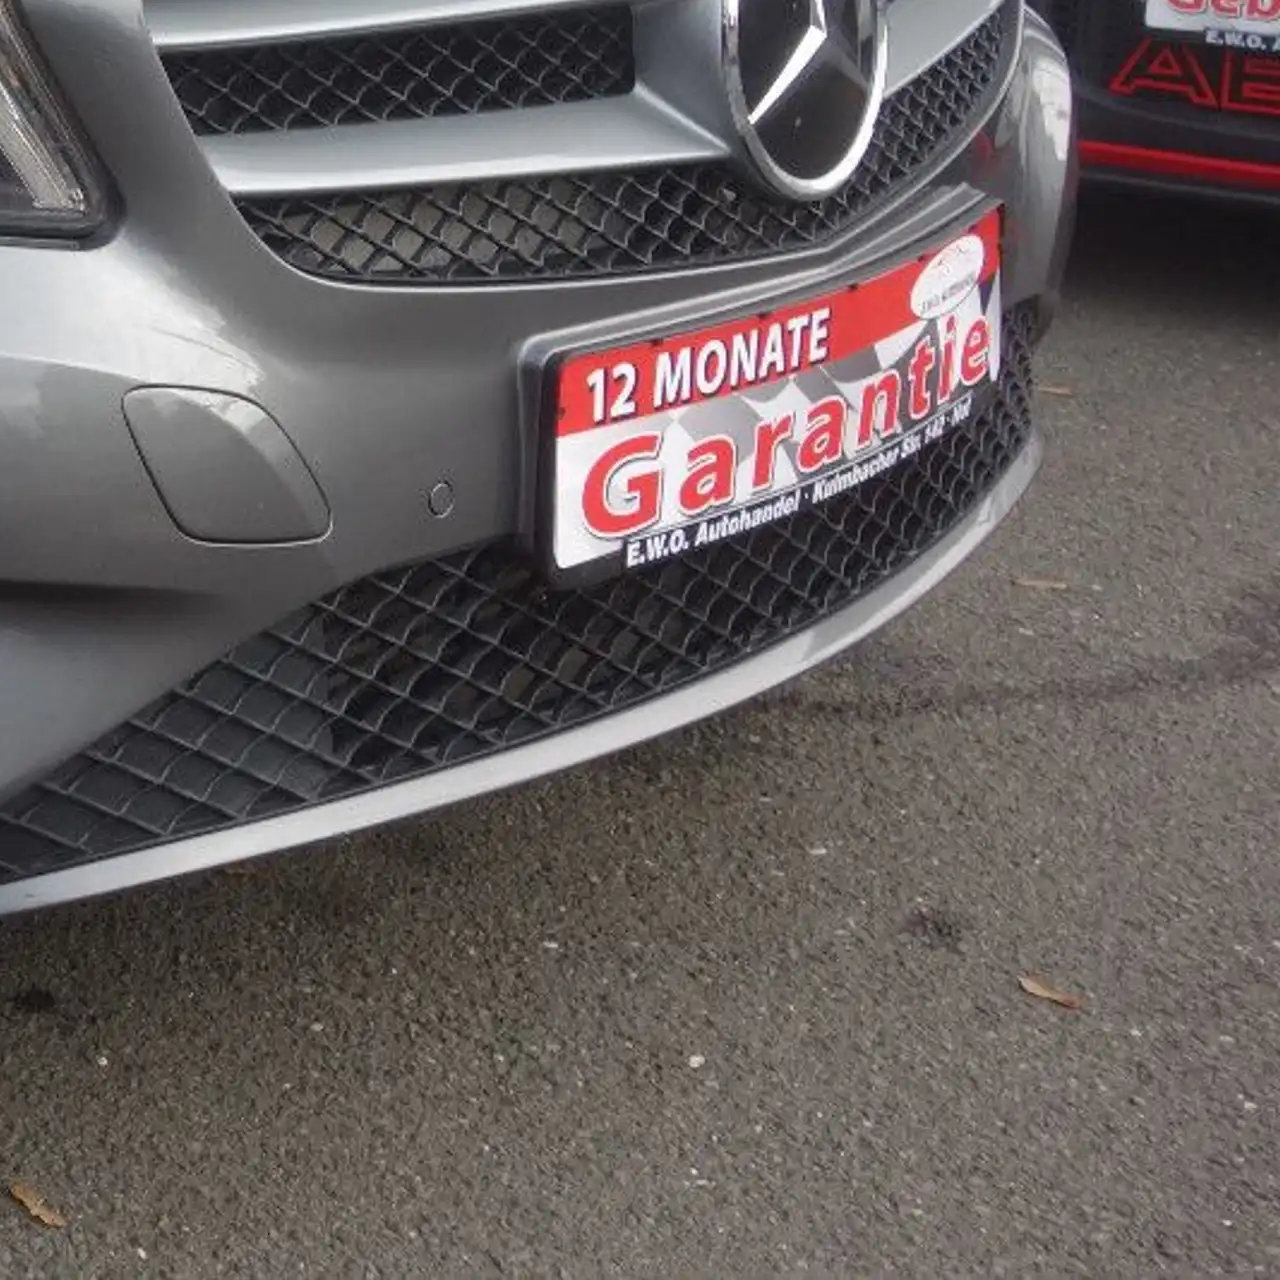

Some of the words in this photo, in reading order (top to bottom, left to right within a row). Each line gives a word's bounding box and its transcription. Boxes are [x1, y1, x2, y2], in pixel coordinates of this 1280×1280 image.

[586, 361, 640, 424] 12
[653, 307, 832, 410] MONATE
[580, 312, 990, 540] Garantie
[625, 527, 690, 569] E.W.O.
[694, 487, 802, 548] Autohandel
